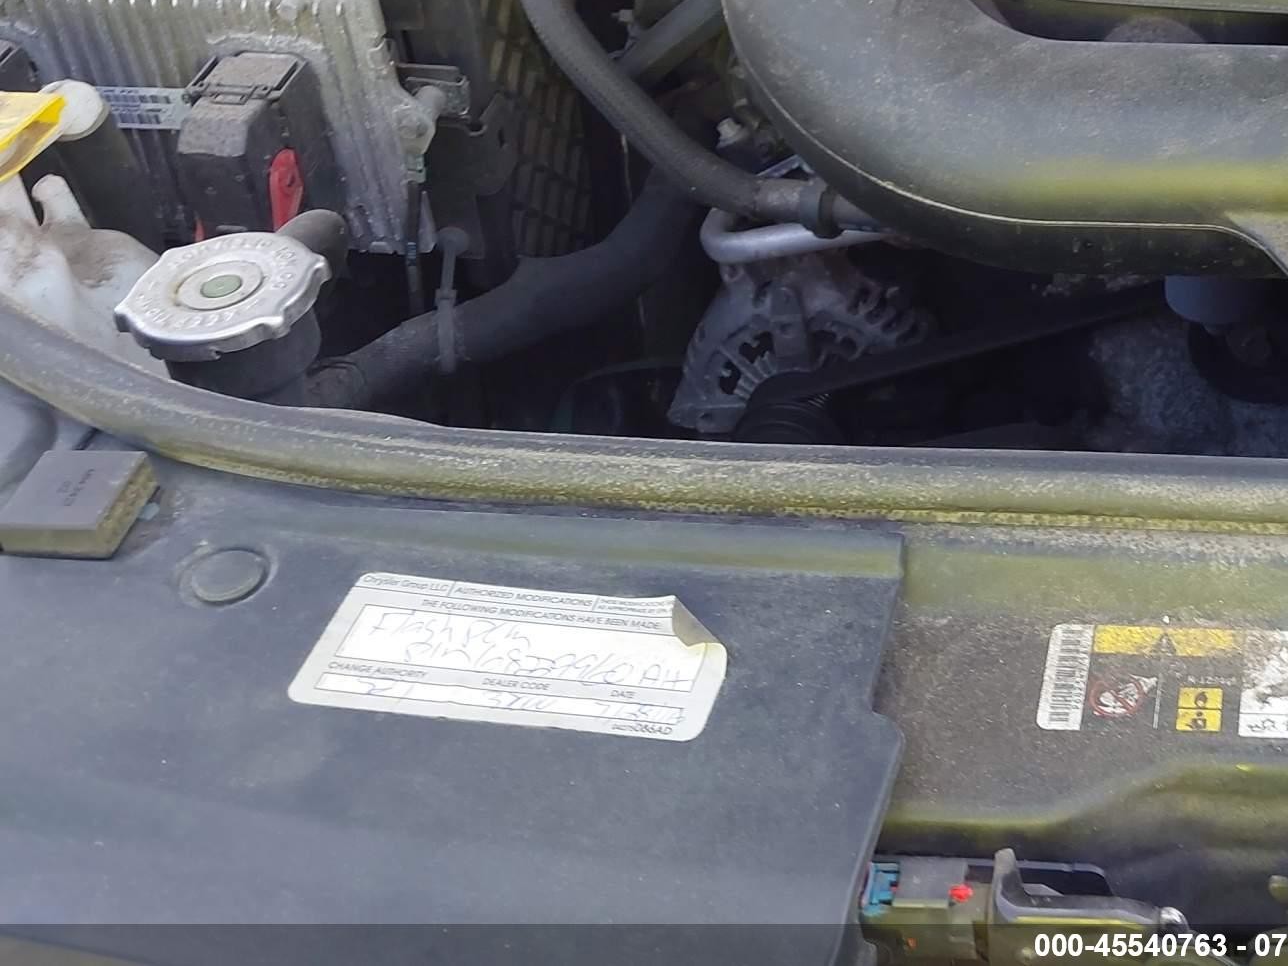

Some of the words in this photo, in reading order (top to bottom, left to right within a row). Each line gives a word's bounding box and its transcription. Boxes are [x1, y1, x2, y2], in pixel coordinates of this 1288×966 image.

[429, 581, 449, 593] LLC
[455, 587, 513, 600] AUTHORIZED
[515, 592, 592, 607] MODIFICATIONS
[422, 598, 438, 608] THE
[440, 601, 497, 614] FOLLOWING
[500, 607, 577, 622] MODIFICATIONS
[577, 615, 602, 625] HAVE
[606, 618, 629, 627] BEEN
[328, 661, 373, 674] CHANGE
[374, 665, 428, 679] AUTHORITY
[482, 677, 520, 689] DEALER
[521, 680, 551, 692] CODE
[610, 689, 636, 700] DATE
